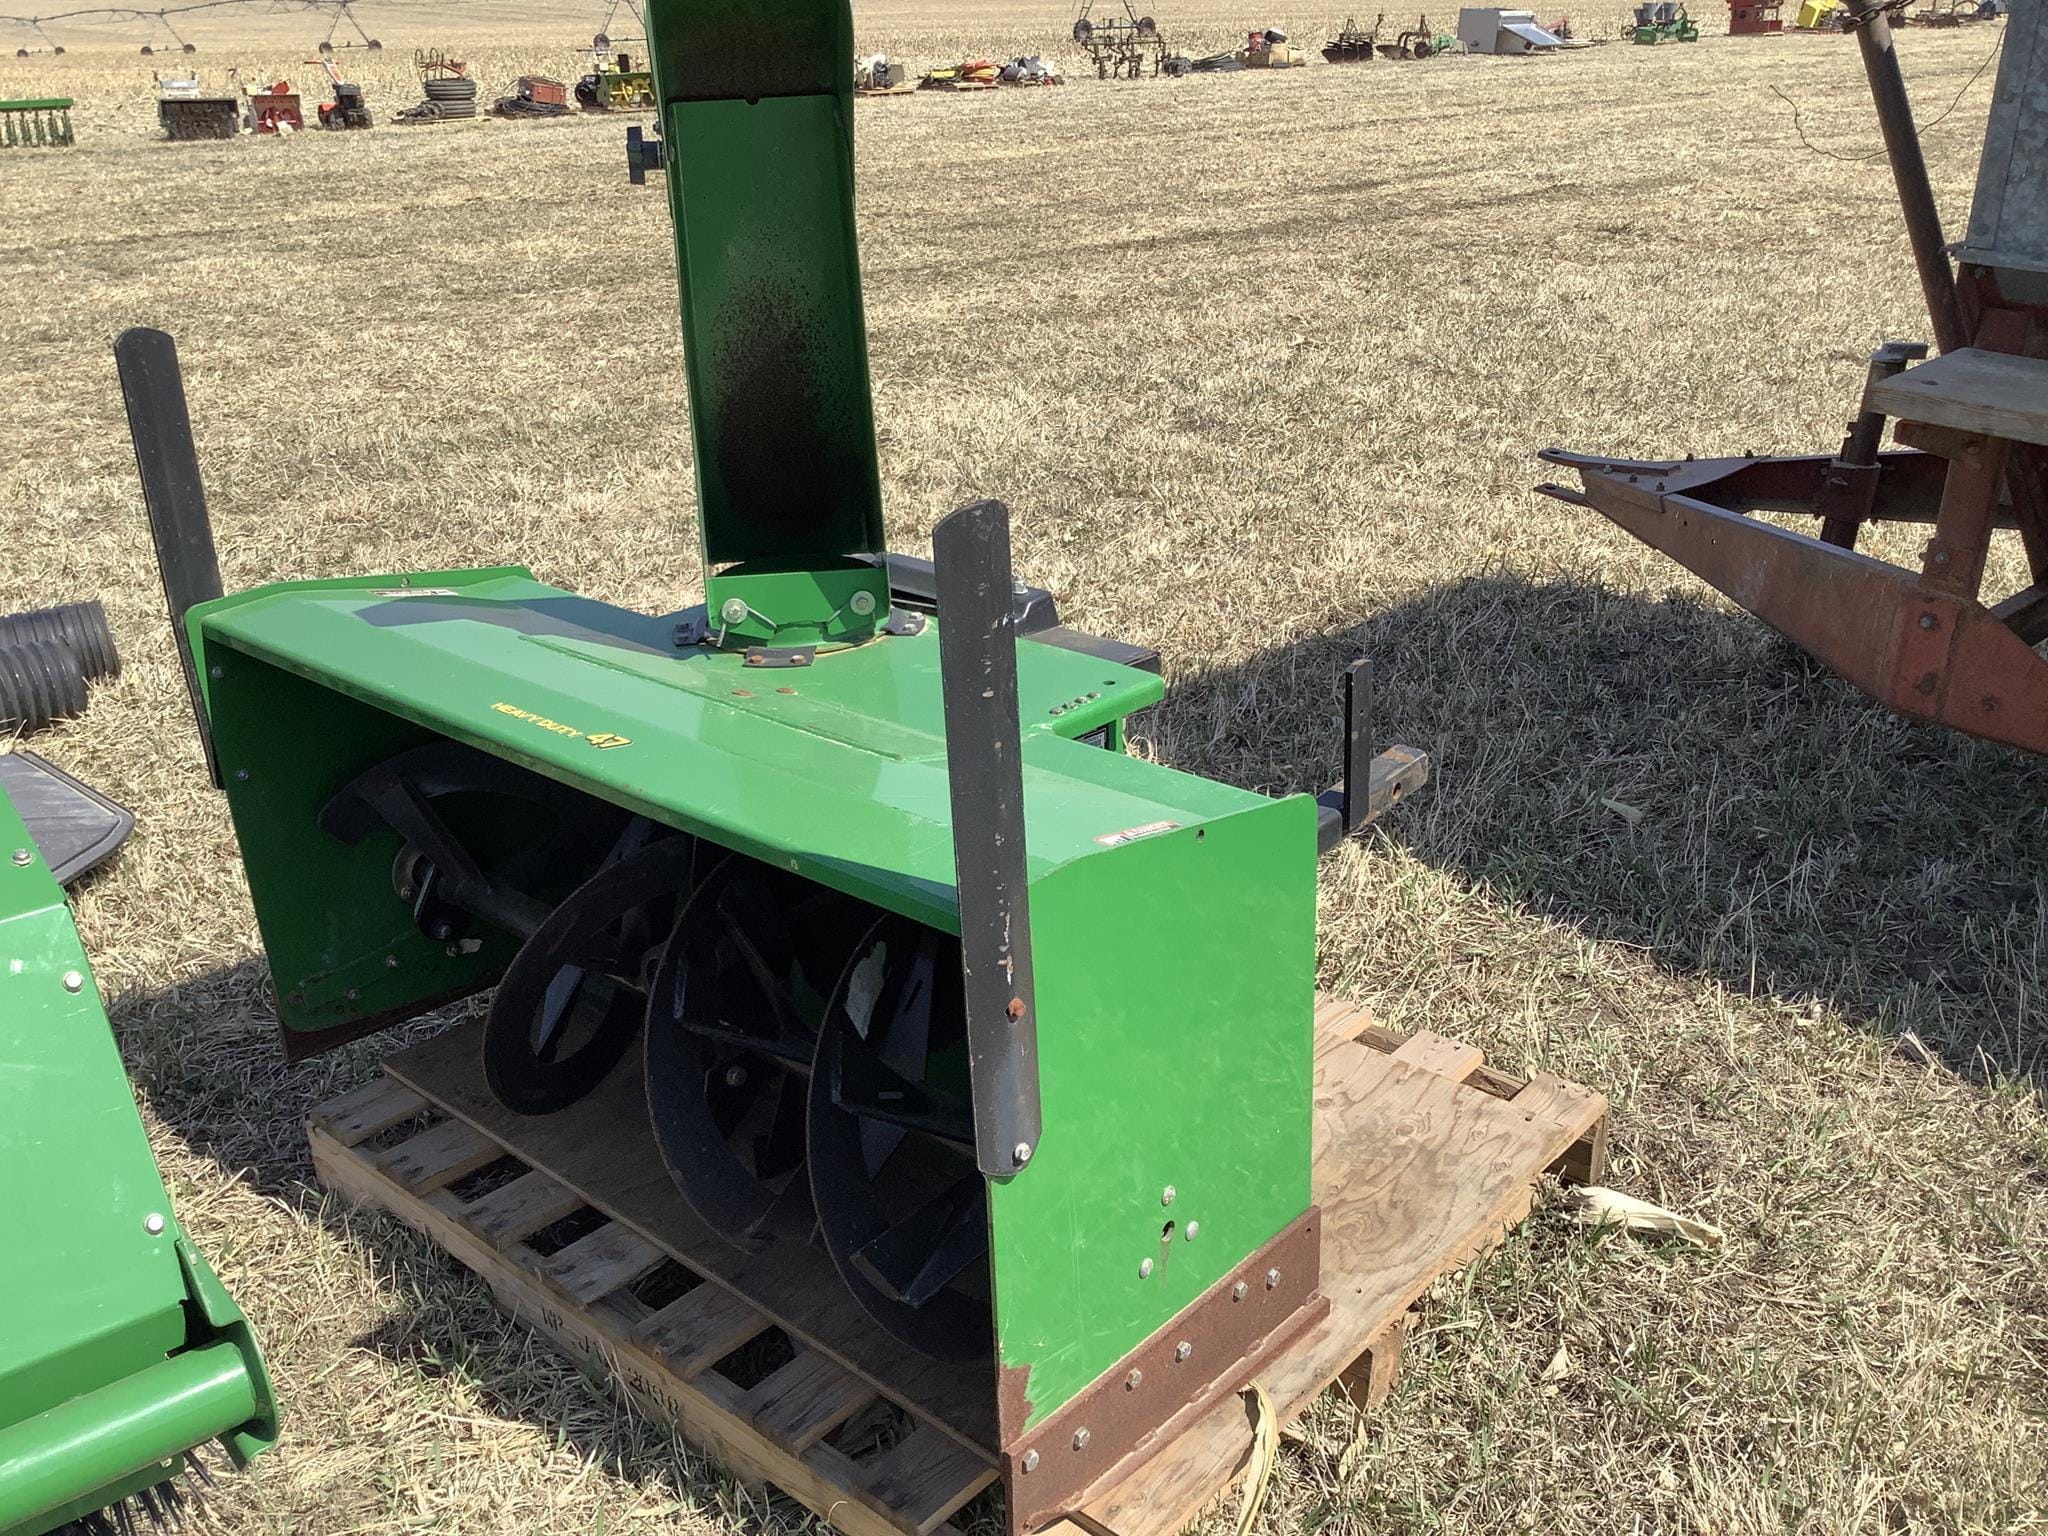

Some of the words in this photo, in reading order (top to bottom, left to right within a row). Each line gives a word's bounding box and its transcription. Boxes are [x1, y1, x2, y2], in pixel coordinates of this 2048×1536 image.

[490, 702, 543, 723] HEAVY
[535, 719, 584, 739] DUTY
[584, 733, 633, 750] 47
